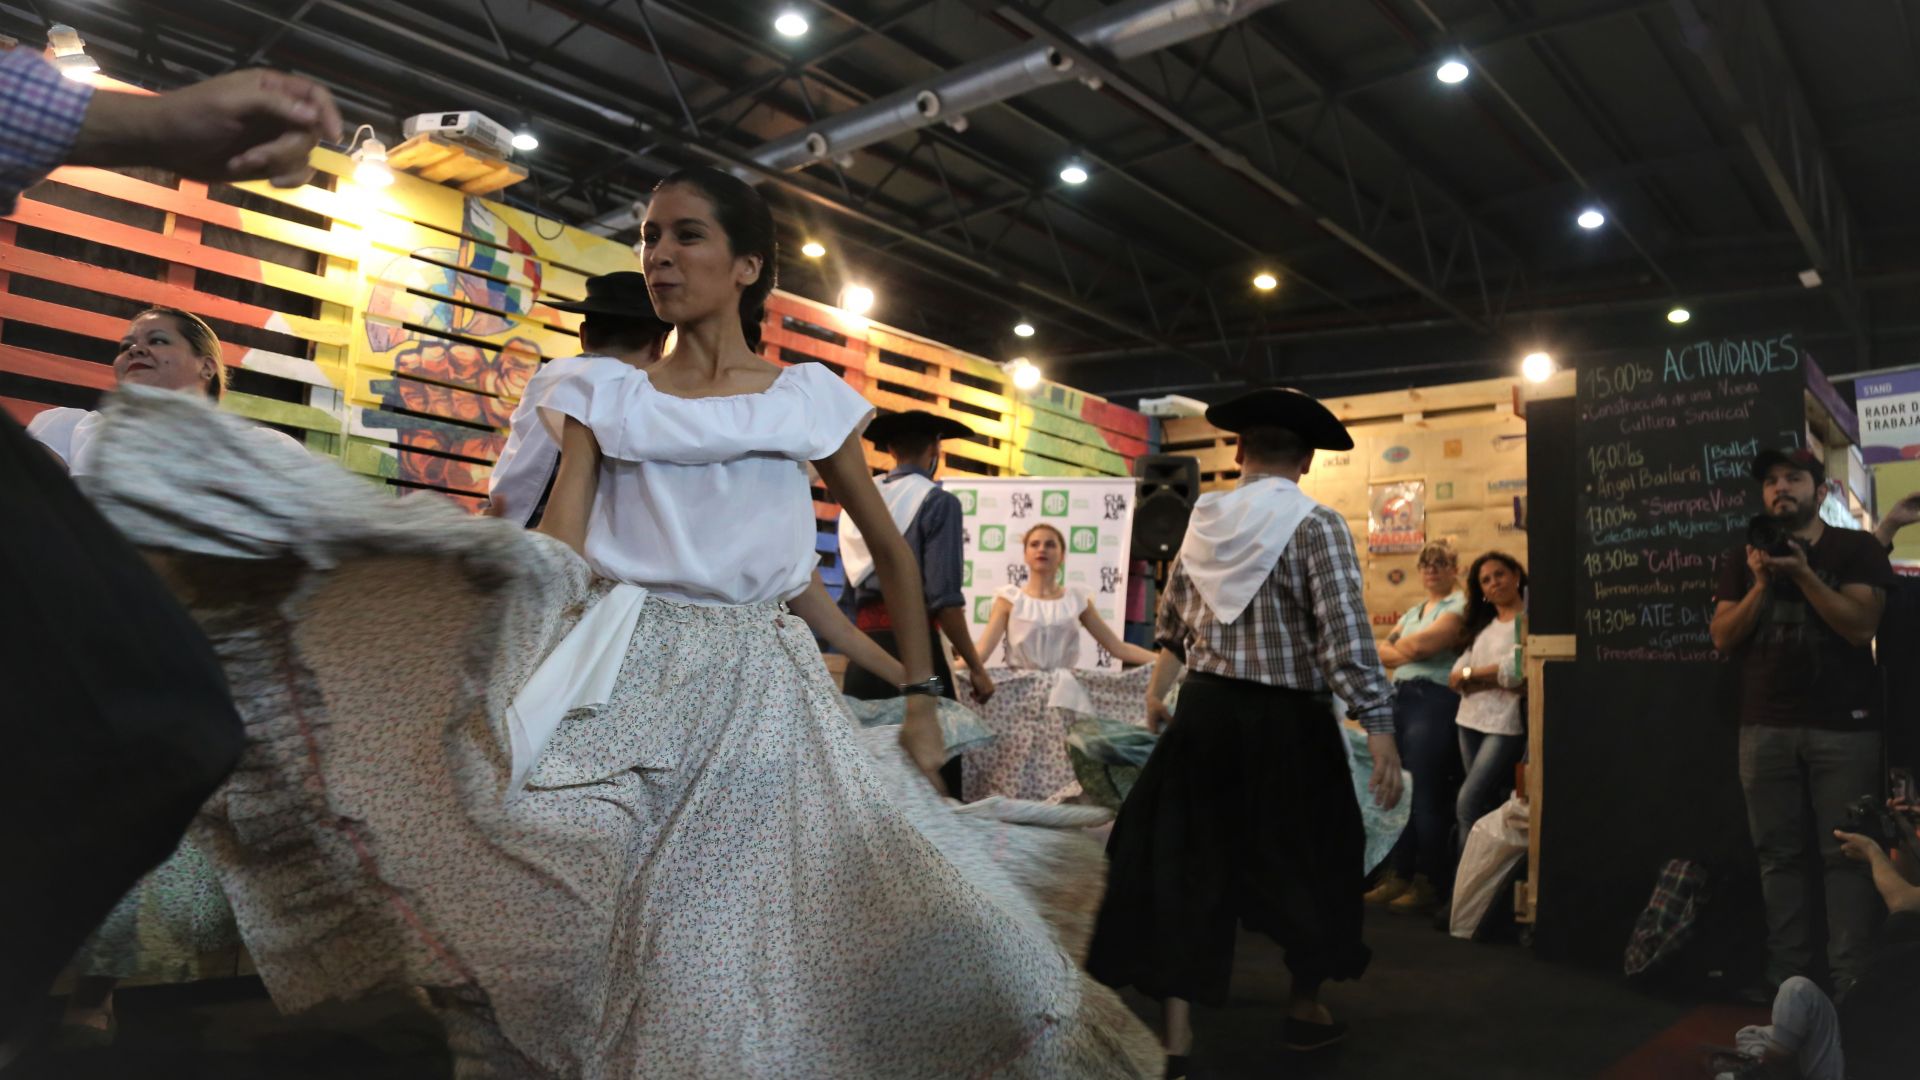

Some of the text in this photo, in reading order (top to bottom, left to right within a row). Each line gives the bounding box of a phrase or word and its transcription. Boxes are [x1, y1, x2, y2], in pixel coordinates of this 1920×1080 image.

[1664, 333, 1798, 383] ACTIVIDADES
[1863, 383, 1892, 397] STAND
[1865, 400, 1920, 418] RADAR D
[1619, 417, 1677, 434] Cultura
[1867, 415, 1920, 432] TRABAJA
[1706, 554, 1717, 572] y
[1594, 577, 1676, 600] Herramientas
[1682, 577, 1706, 592] para
